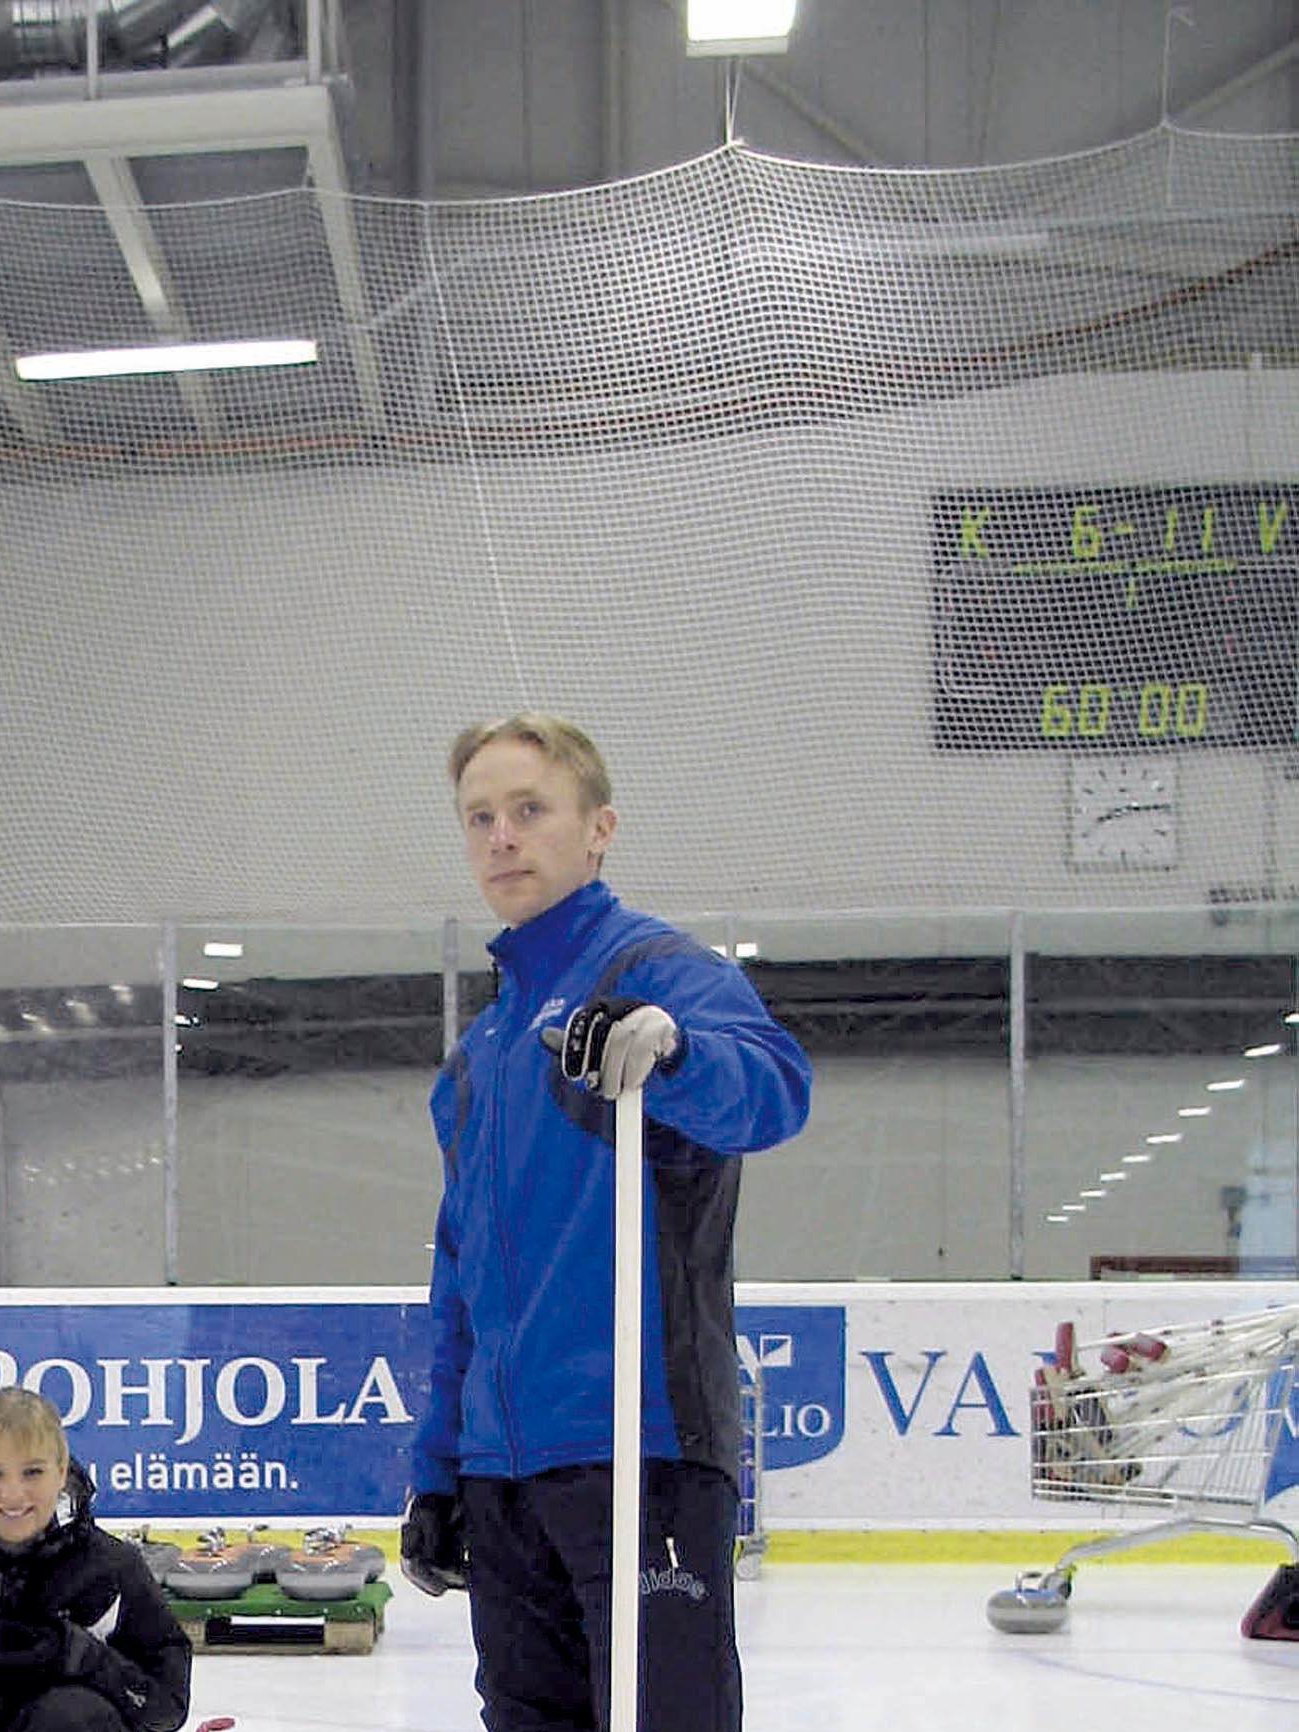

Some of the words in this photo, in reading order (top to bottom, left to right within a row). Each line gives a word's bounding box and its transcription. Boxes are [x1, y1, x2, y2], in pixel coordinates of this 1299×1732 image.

[961, 505, 990, 558] K
[1258, 500, 1289, 554] V
[110, 1452, 299, 1491] elämään.
